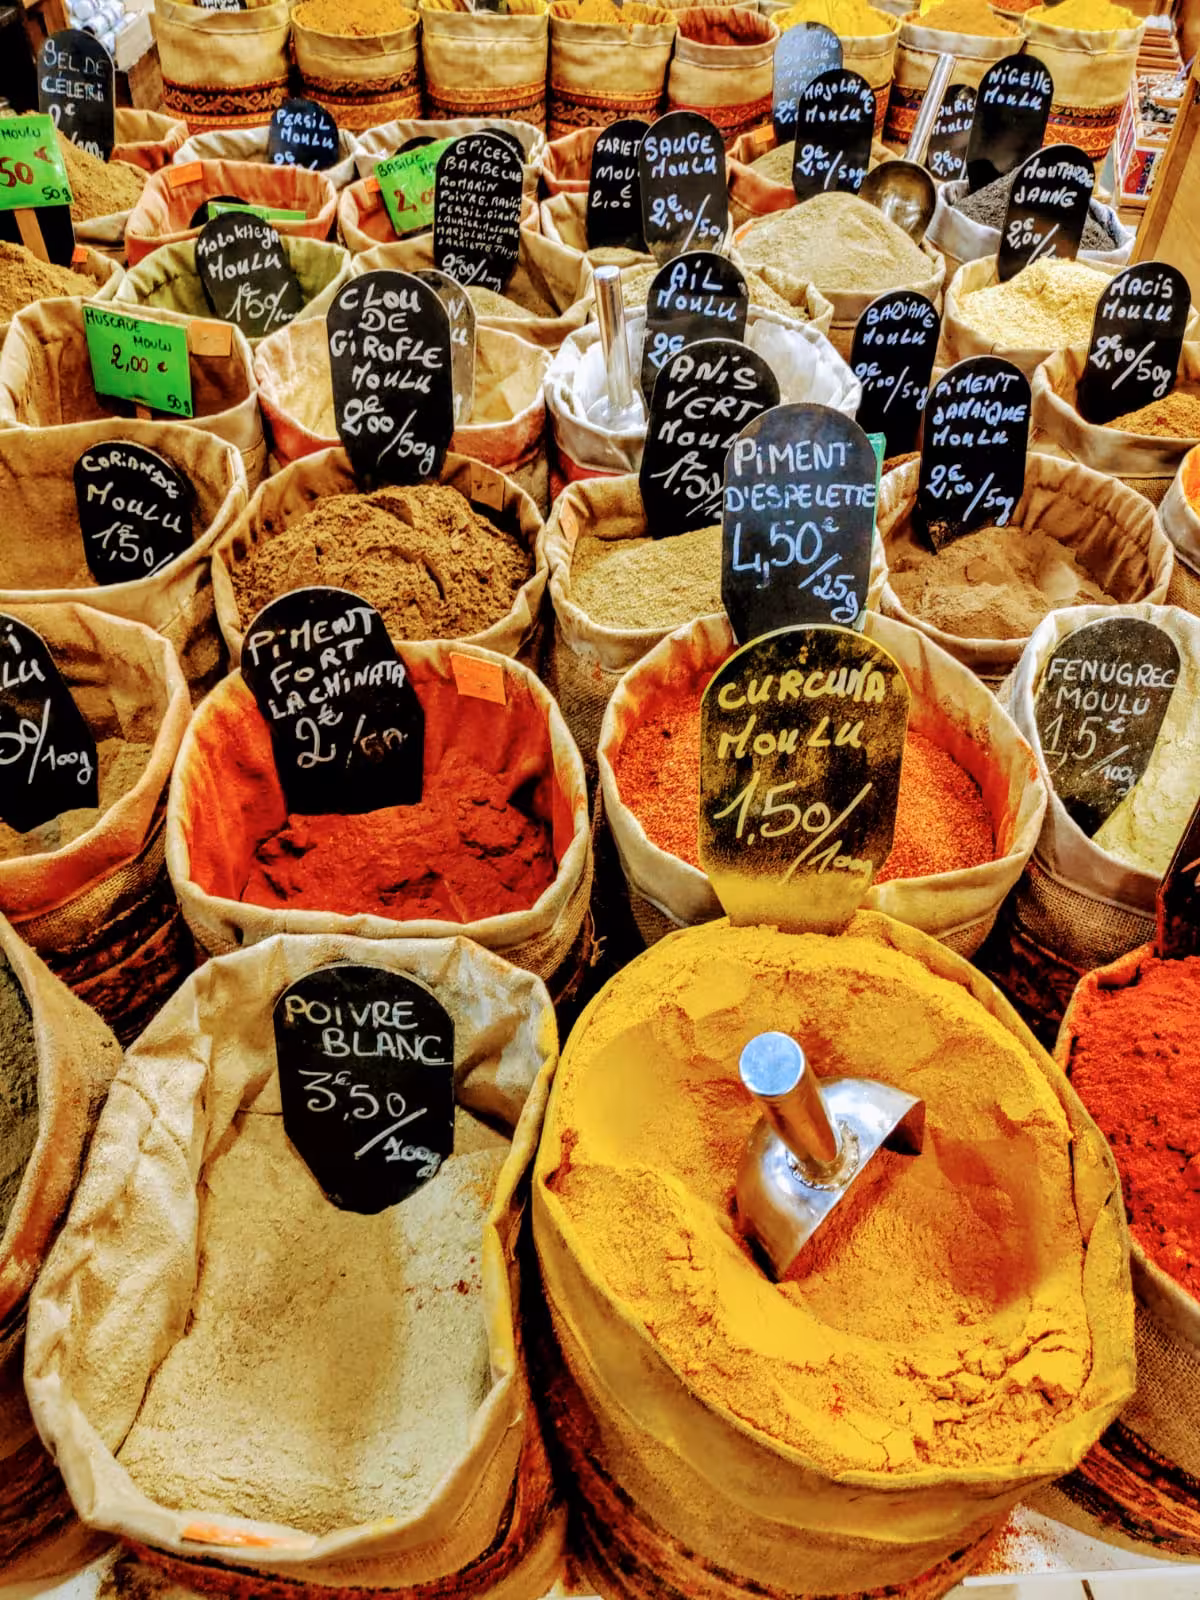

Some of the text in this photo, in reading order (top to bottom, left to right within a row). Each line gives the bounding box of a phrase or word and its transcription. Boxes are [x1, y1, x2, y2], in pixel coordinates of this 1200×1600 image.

[596, 138, 640, 157] SARIET
[644, 132, 715, 162] SAUGE
[596, 165, 640, 181] MOU
[1014, 185, 1078, 208] JAUNE
[339, 282, 422, 315] CLOU
[1101, 298, 1173, 321] MOULU
[358, 307, 409, 333] DE
[862, 326, 927, 346] MOULU
[665, 386, 764, 422] VERT
[658, 418, 741, 450] MOUL
[932, 425, 1009, 448] MOULU
[86, 481, 183, 534] MOULU
[725, 482, 877, 513] D'ESPELETTE
[270, 637, 365, 695] FORT
[1047, 657, 1177, 689] FENUGREC
[717, 660, 887, 711] CURCUMA
[1055, 687, 1151, 716] MOULU
[717, 714, 865, 760] MOULU
[322, 1027, 454, 1066] BLANC
